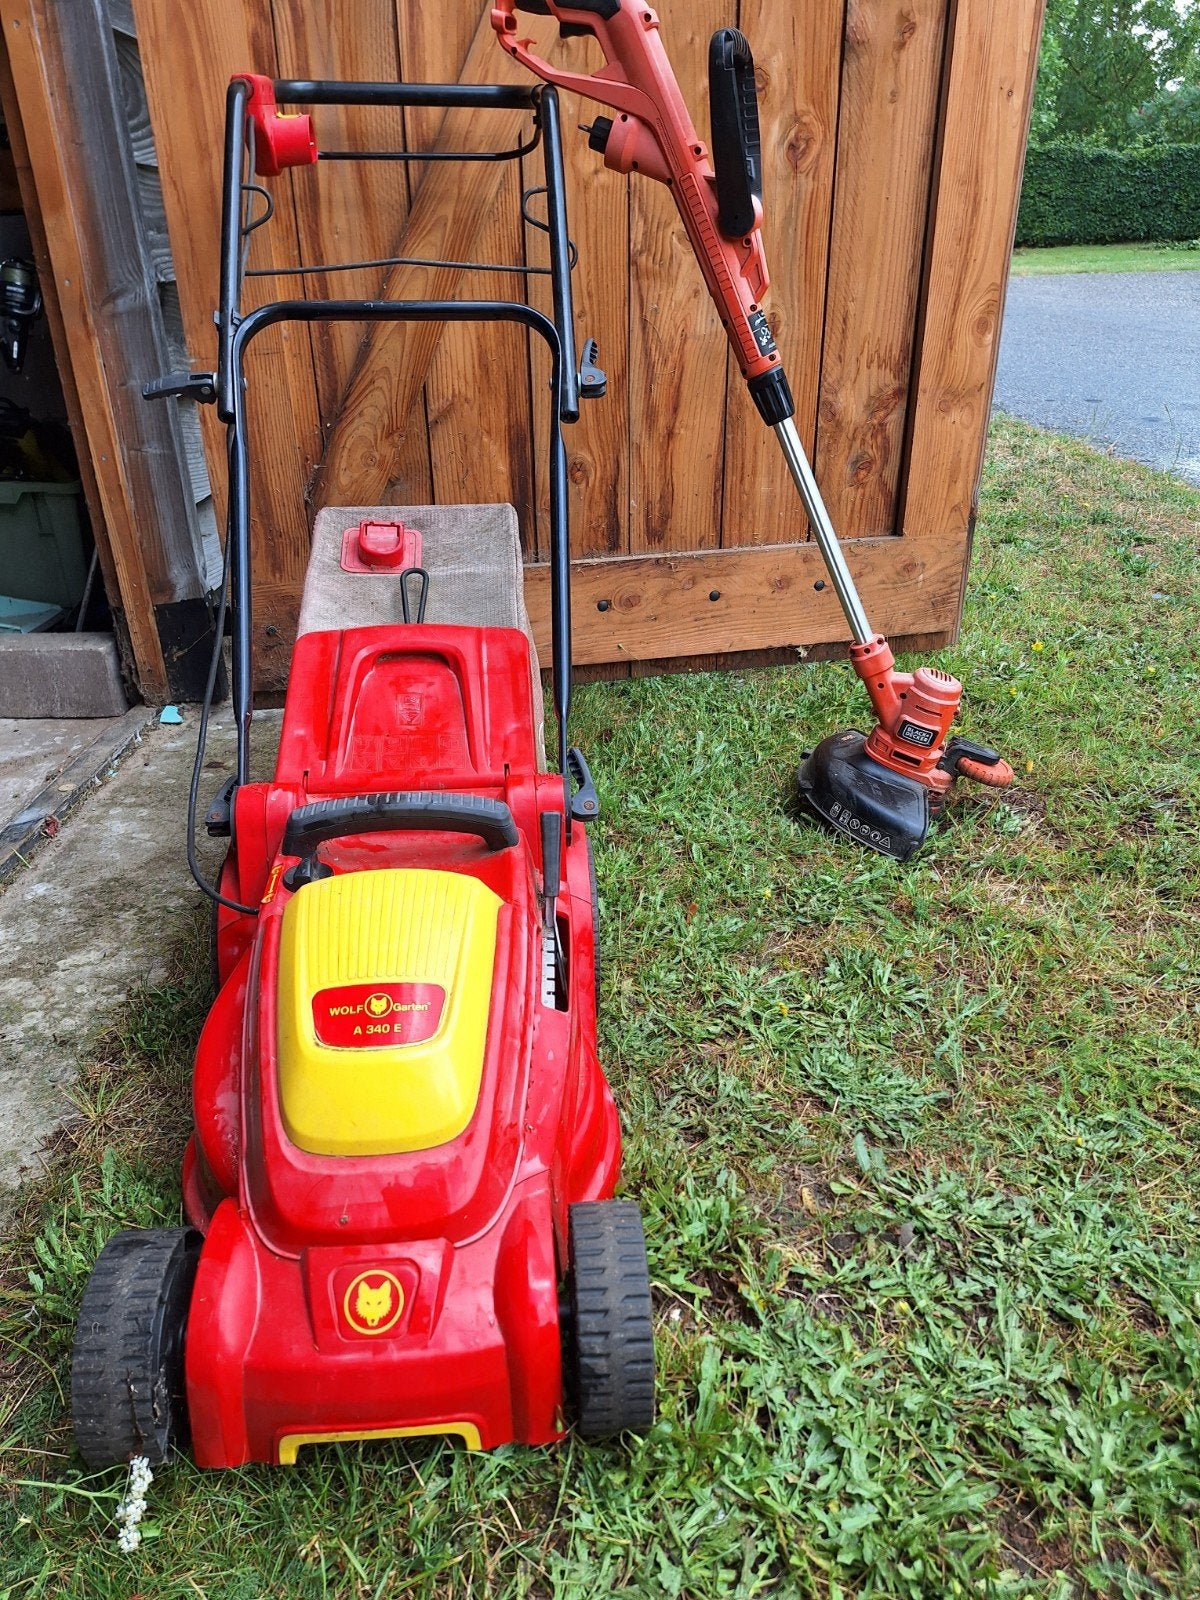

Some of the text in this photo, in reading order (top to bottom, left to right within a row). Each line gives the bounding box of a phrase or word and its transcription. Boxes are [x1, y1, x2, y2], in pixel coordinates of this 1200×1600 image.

[905, 731, 929, 742] DECKER
[329, 1002, 428, 1016] WOLF Garten
[353, 1023, 402, 1035] A 340 E
